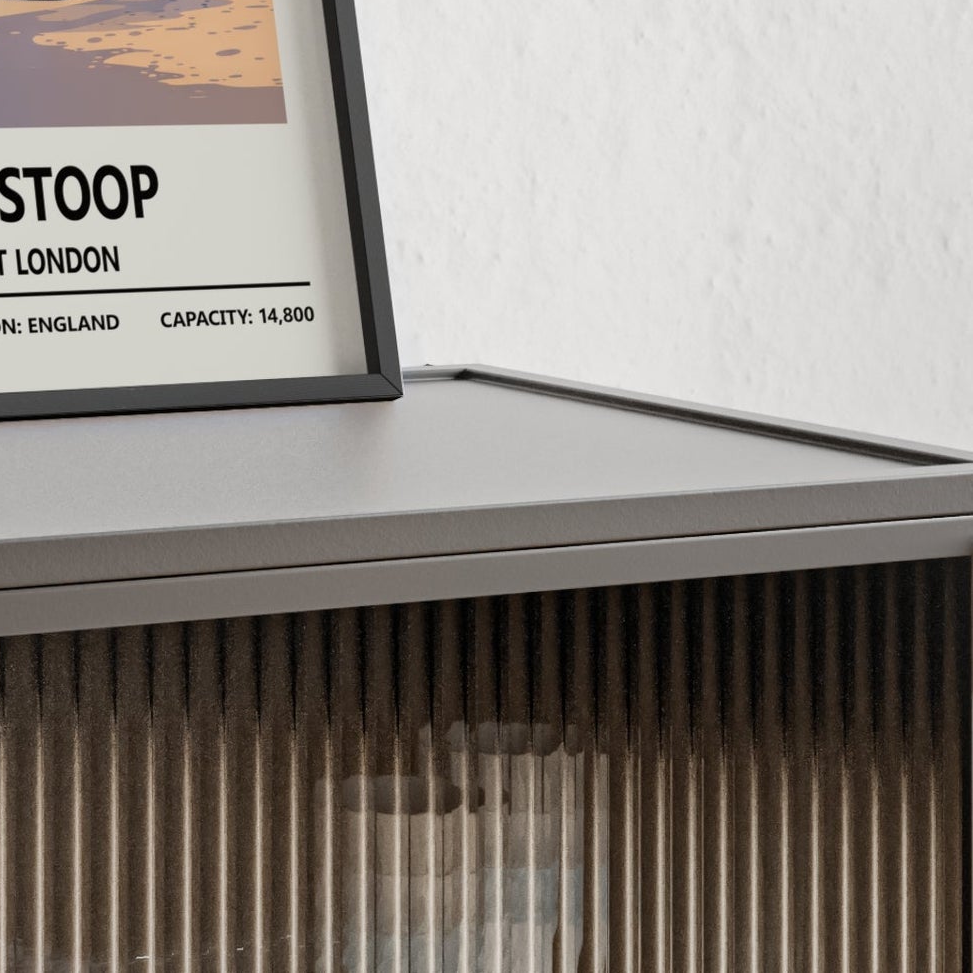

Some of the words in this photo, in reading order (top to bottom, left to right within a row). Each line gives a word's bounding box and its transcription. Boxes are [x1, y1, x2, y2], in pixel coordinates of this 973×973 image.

[15, 245, 120, 276] LONDON
[27, 314, 120, 334] ENGLAND
[160, 308, 253, 328] CAPACITY:
[258, 306, 315, 326] 14,800
